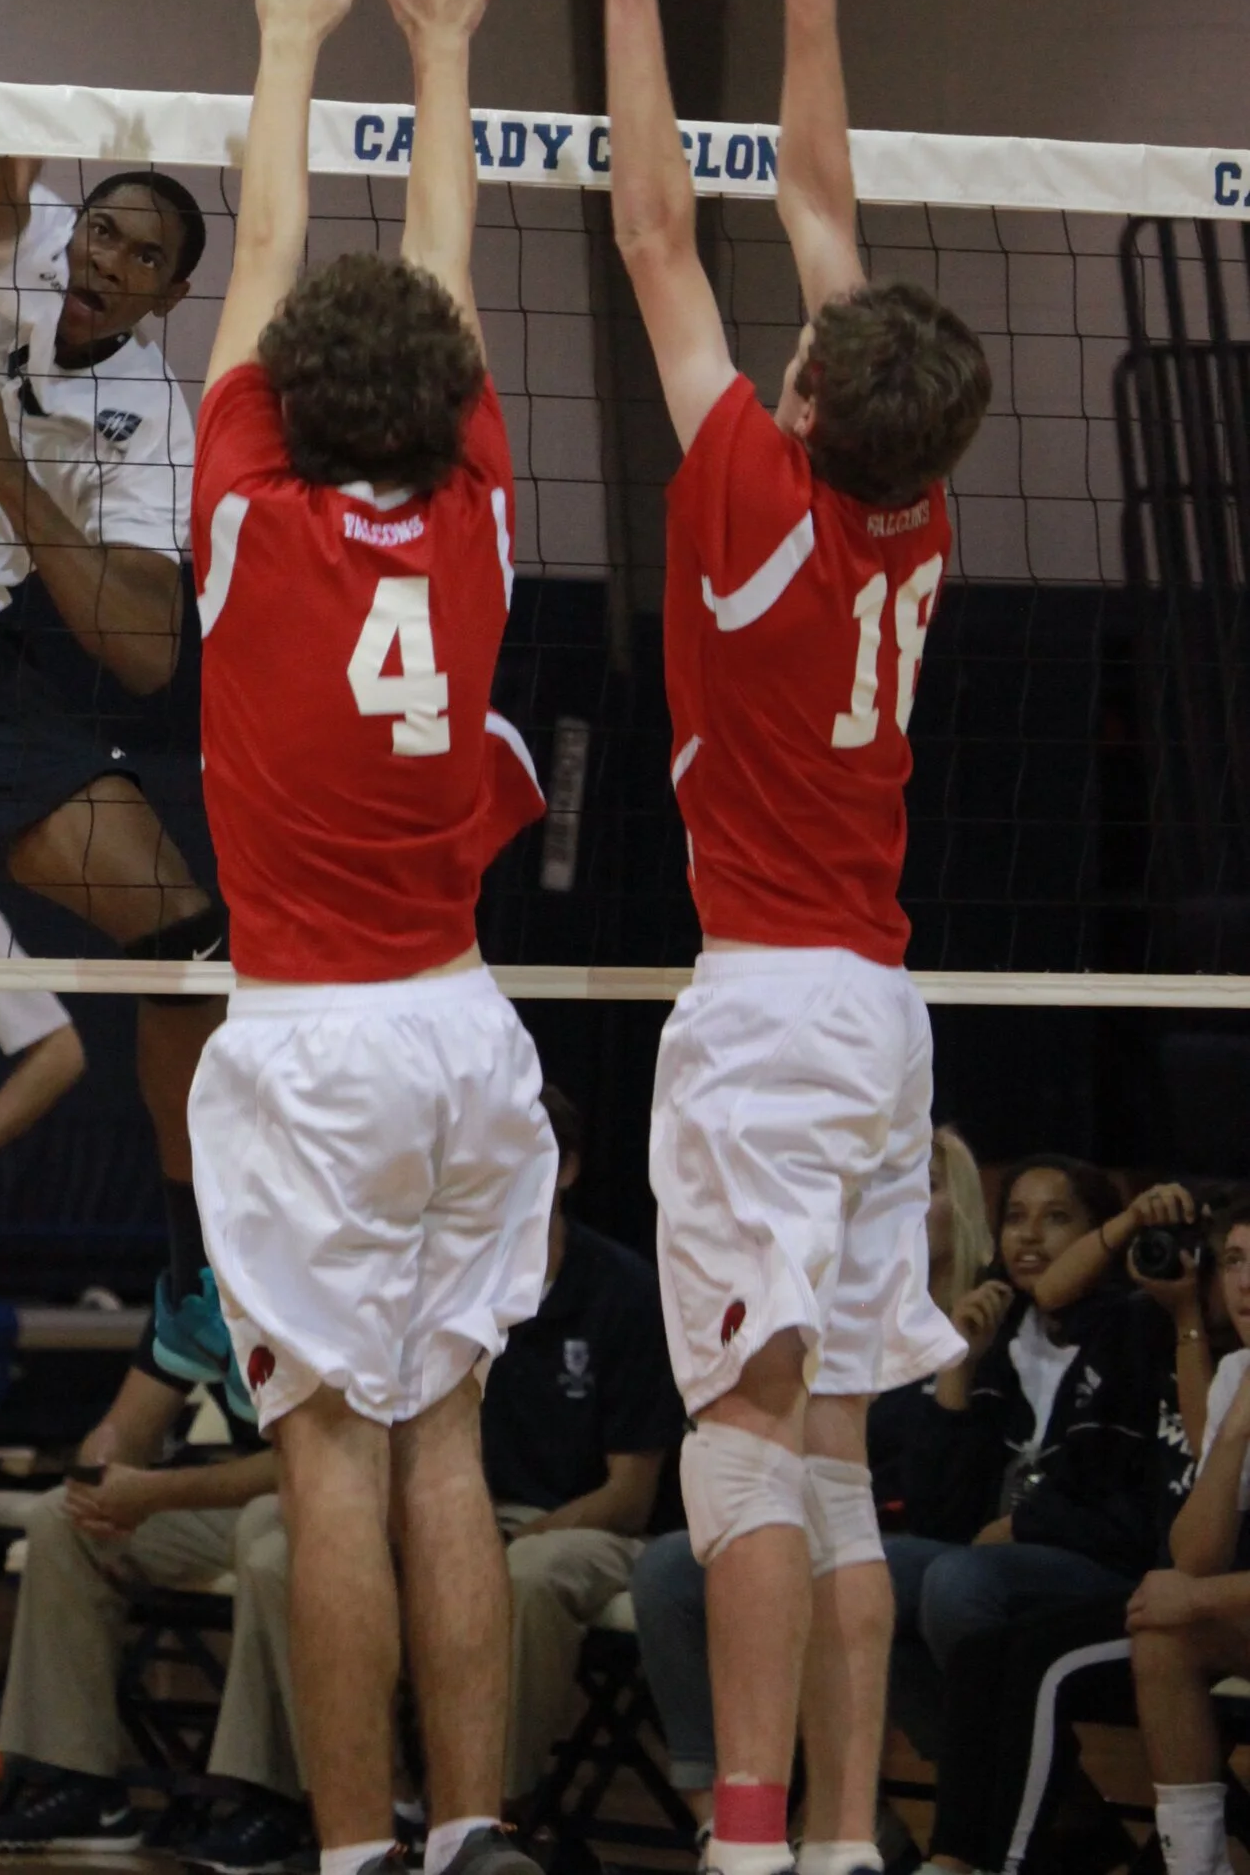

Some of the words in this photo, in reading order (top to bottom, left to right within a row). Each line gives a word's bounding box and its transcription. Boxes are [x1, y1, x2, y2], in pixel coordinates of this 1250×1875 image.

[354, 114, 573, 170] CAADY
[1214, 161, 1250, 207] C
[347, 577, 450, 757] 4
